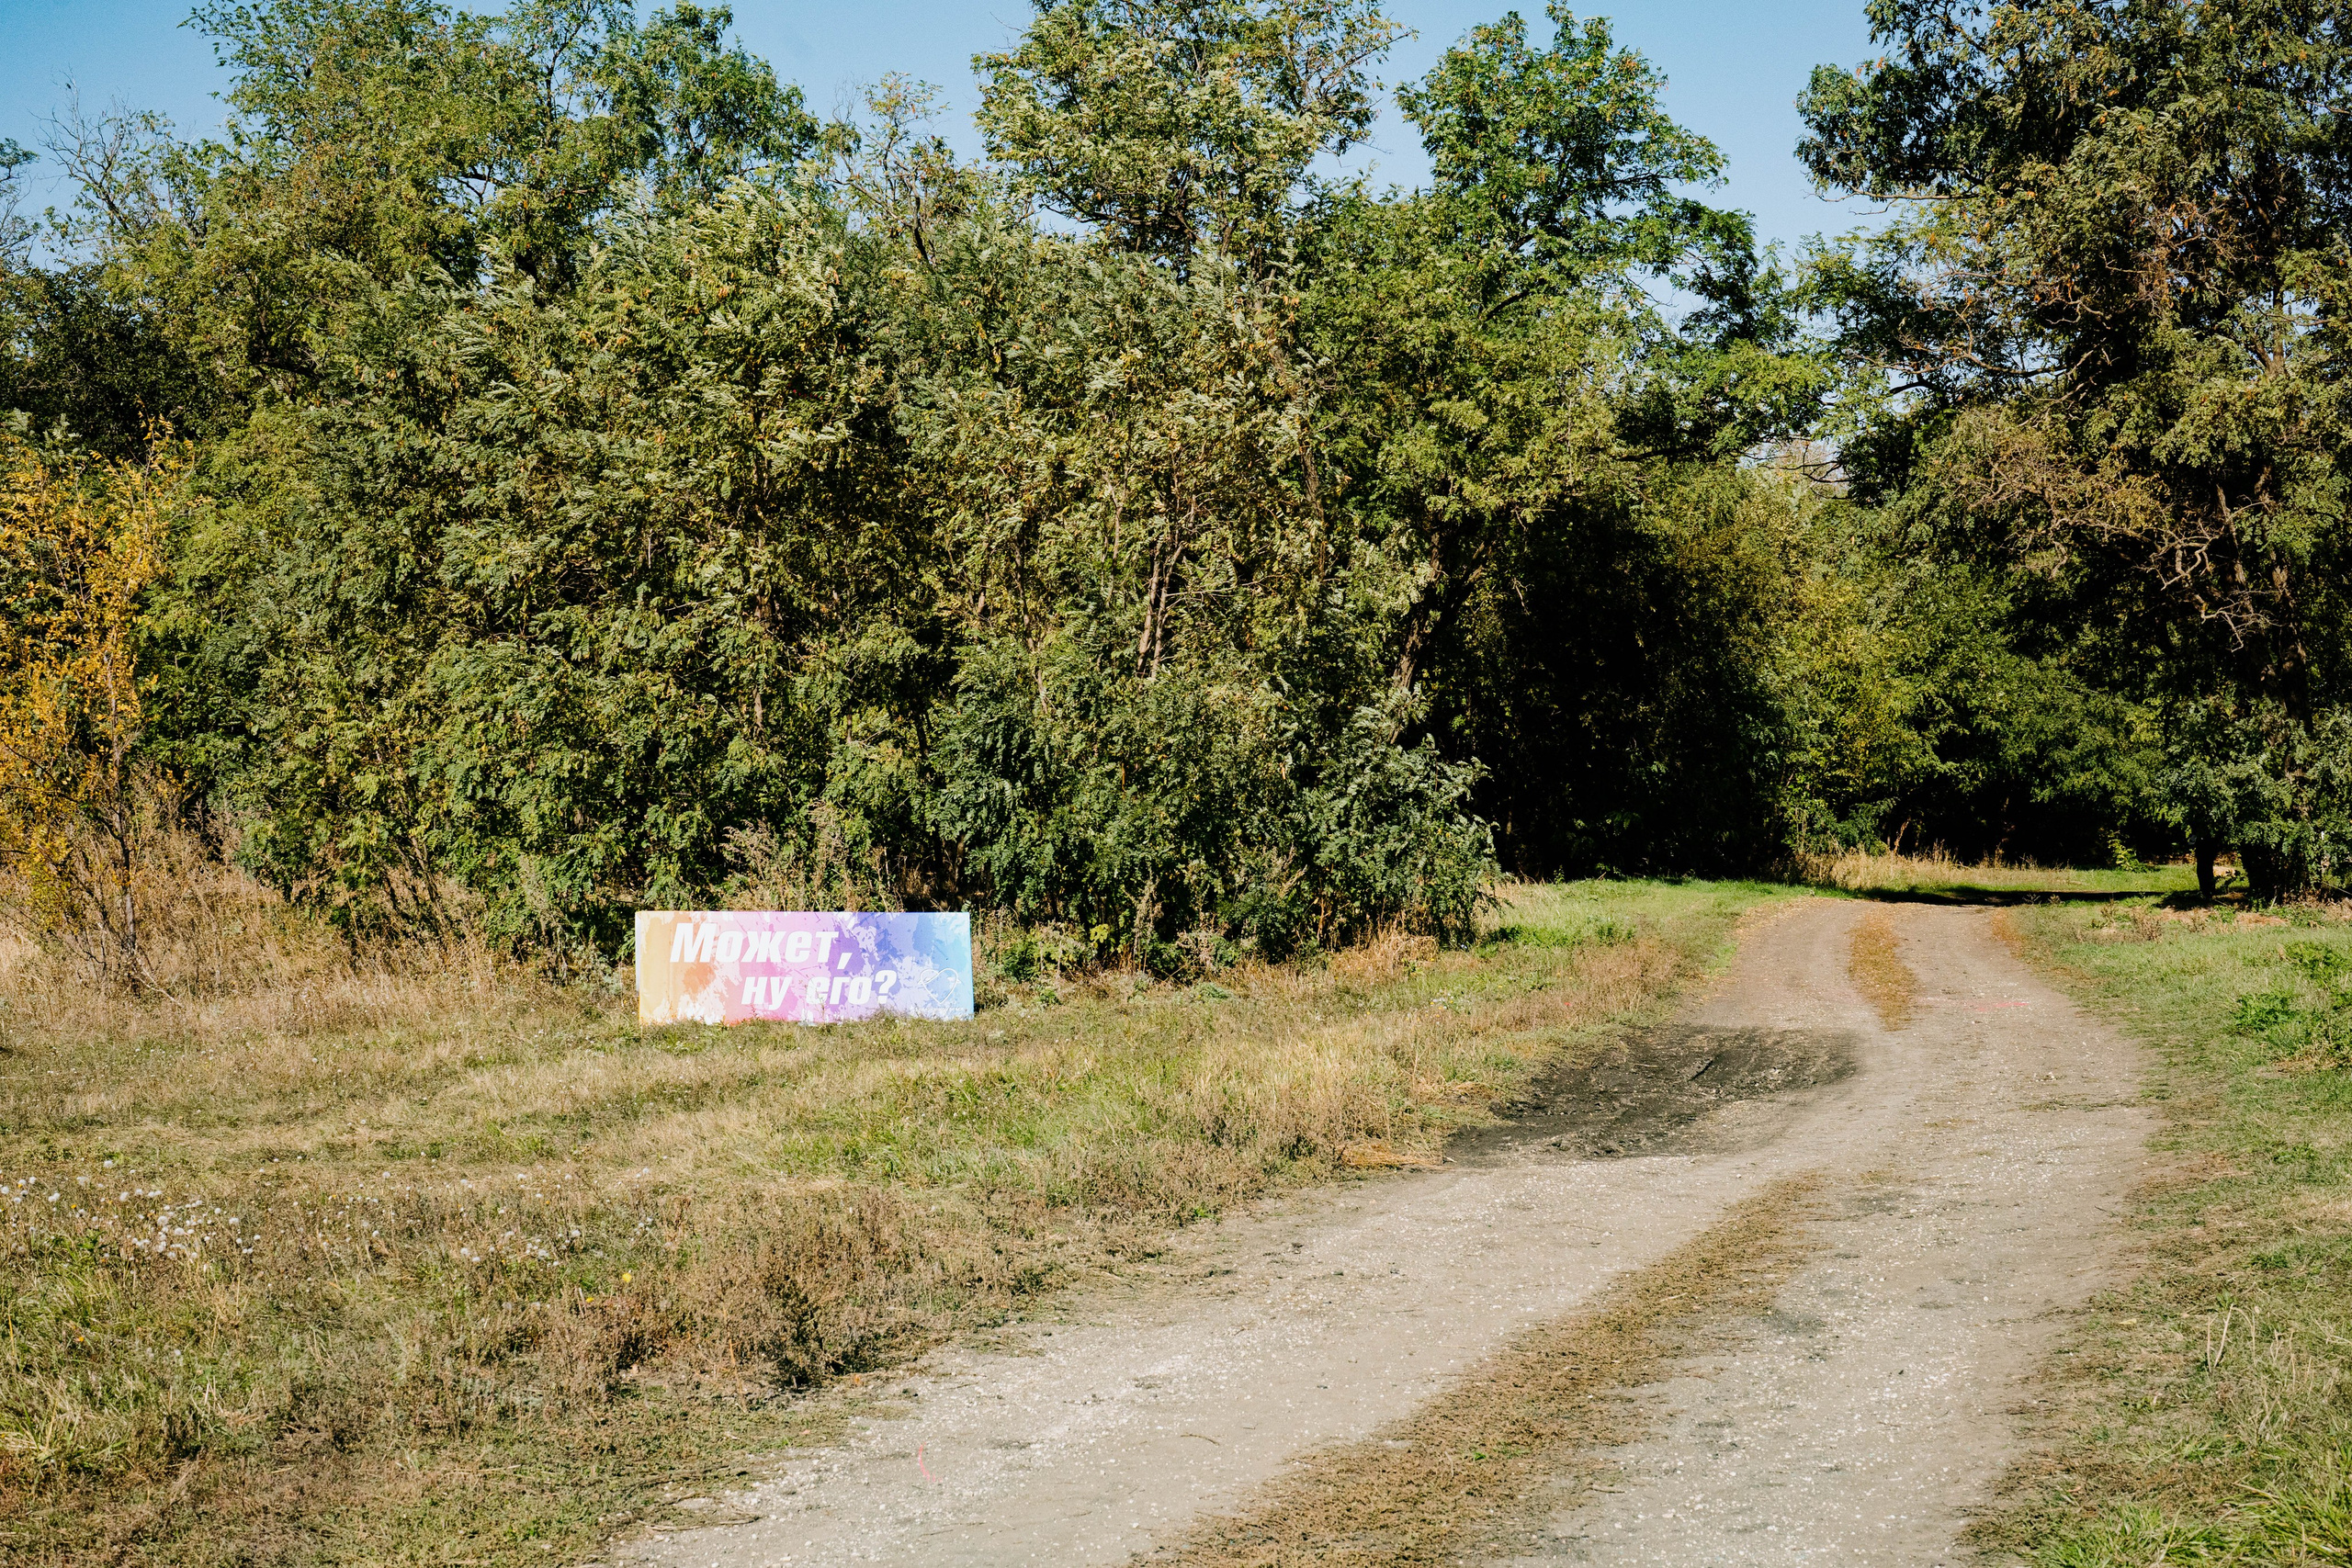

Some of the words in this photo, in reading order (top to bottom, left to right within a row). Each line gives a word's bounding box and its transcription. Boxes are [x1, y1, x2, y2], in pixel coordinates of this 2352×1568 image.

[669, 922, 853, 970] Может,
[741, 976, 793, 1010] ну
[806, 969, 898, 1005] его?
